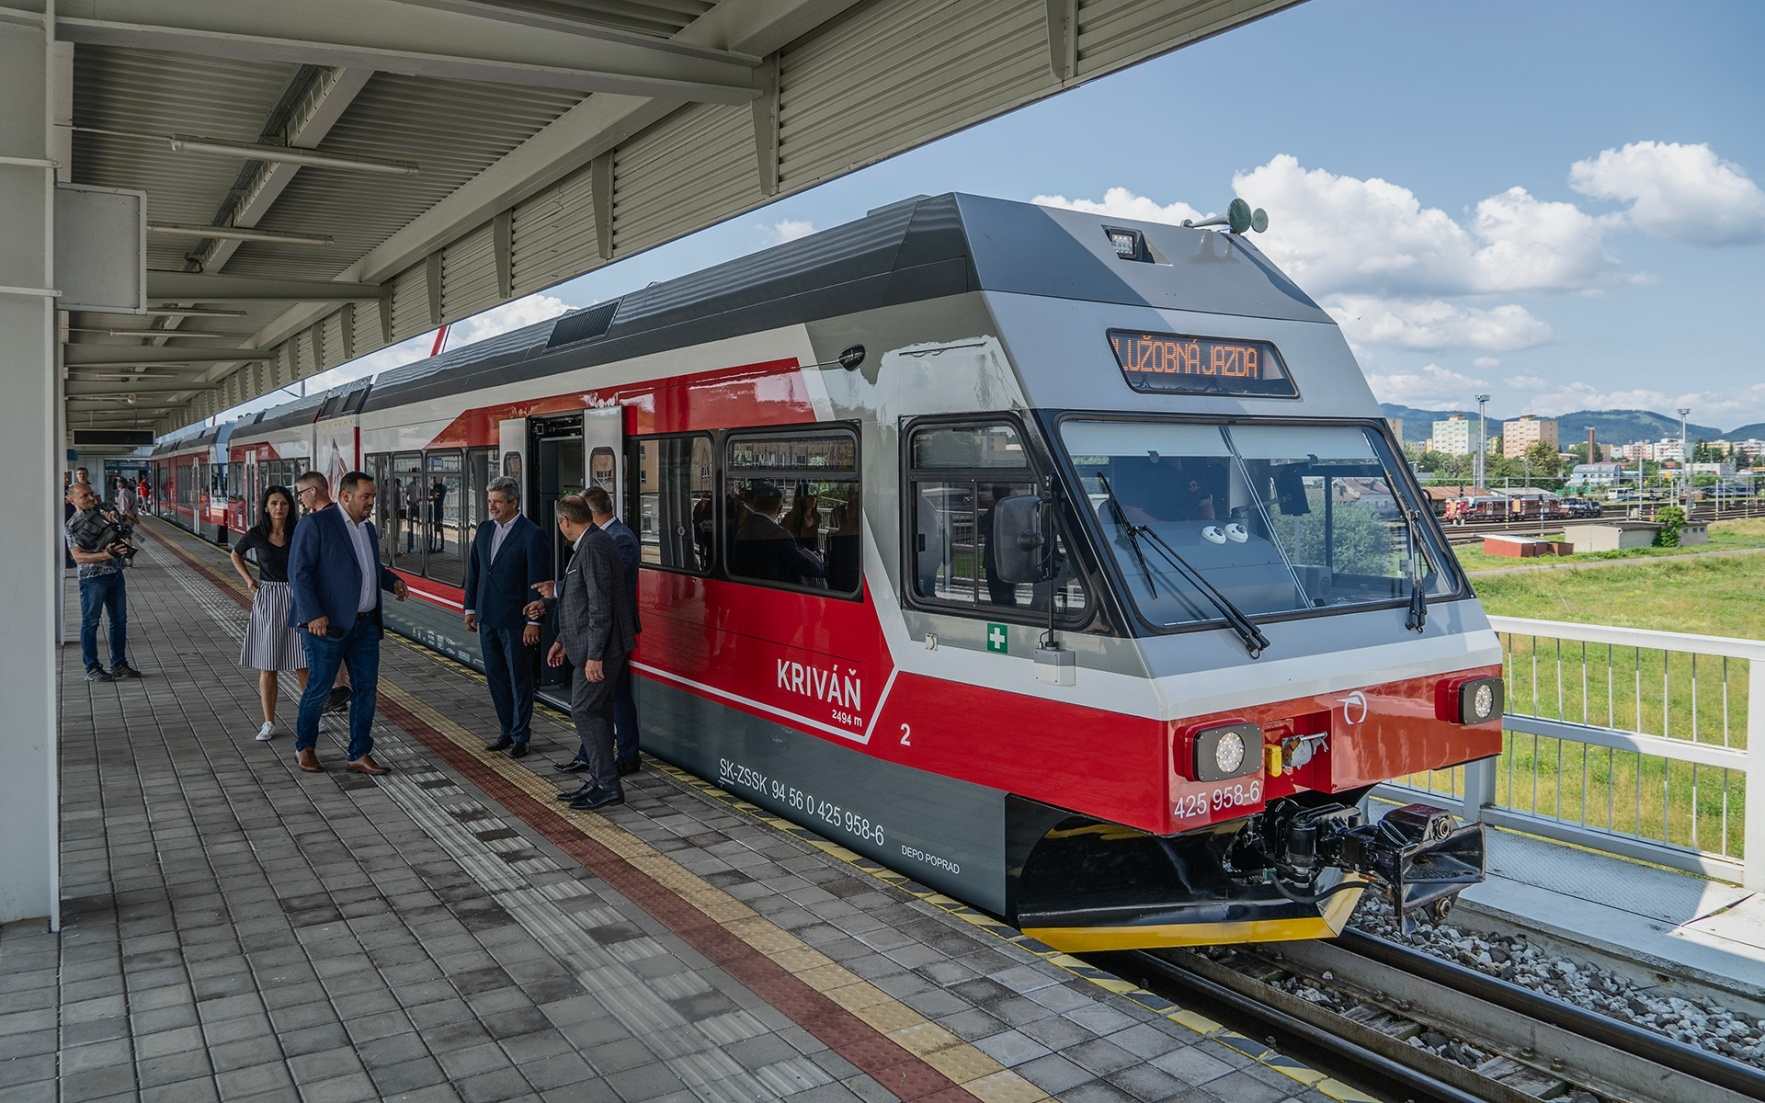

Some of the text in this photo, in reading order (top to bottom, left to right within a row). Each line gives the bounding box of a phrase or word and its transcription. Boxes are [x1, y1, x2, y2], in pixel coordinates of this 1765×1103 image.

[1111, 335, 1257, 377] UŽOBNÁ JAZDA
[777, 659, 861, 710] KRIVÁŇ
[831, 709, 863, 727] 2494 m
[900, 723, 912, 746] 2
[719, 758, 884, 846] SK-ZSSK 94 56 0 425 958-6
[1174, 780, 1260, 819] 425 958-6
[901, 845, 960, 874] DEPO POPRAD
